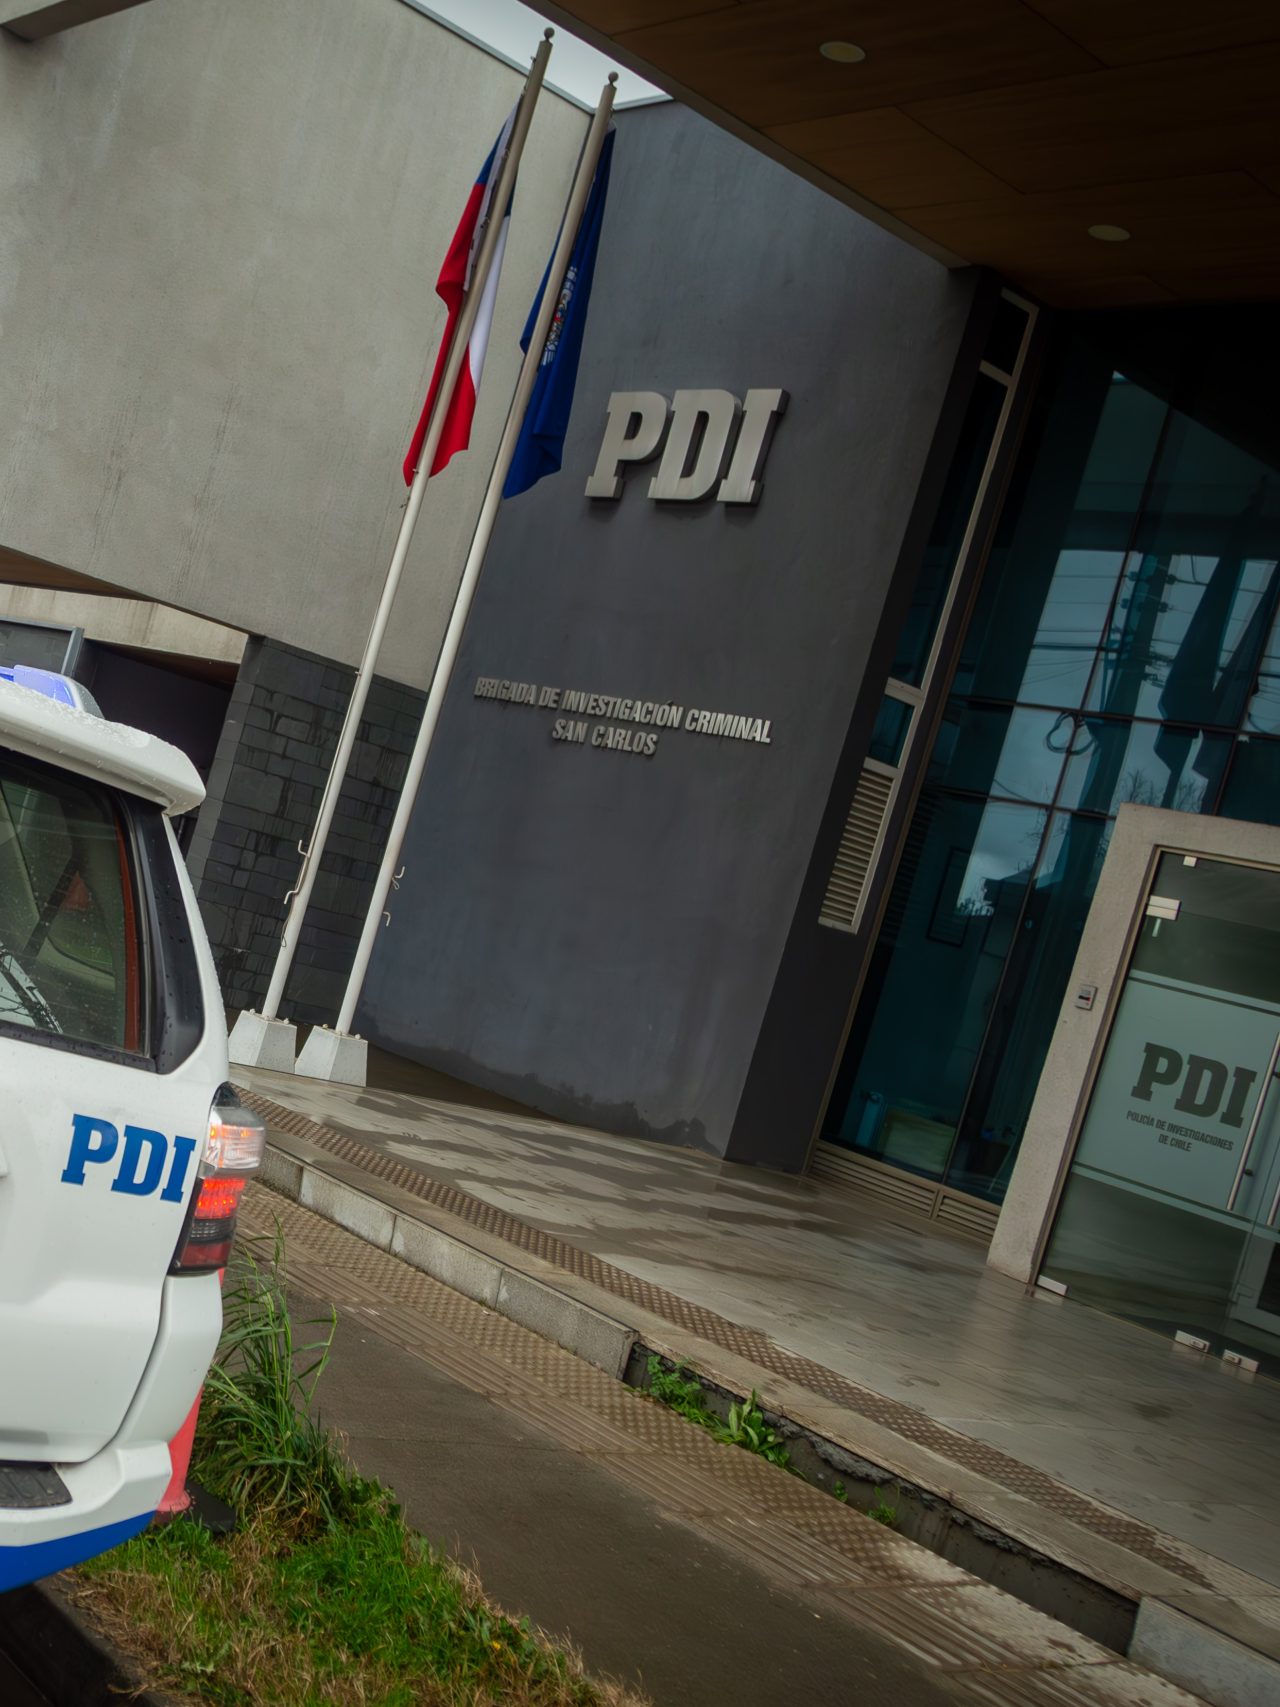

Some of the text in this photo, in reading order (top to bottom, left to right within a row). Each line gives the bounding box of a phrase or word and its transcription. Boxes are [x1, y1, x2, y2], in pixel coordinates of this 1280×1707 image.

[584, 388, 787, 503] PDI
[473, 676, 772, 744] BRIGADA DE INVESTIGACIÓN CRIMINAL
[552, 718, 659, 756] SAN CARLOS
[1130, 1041, 1258, 1129] PDI
[60, 1113, 197, 1204] PDI
[1155, 1119, 1166, 1131] DE
[1166, 1122, 1234, 1151] INVESTIGACIONES
[1158, 1133, 1193, 1152] DE CHILE
